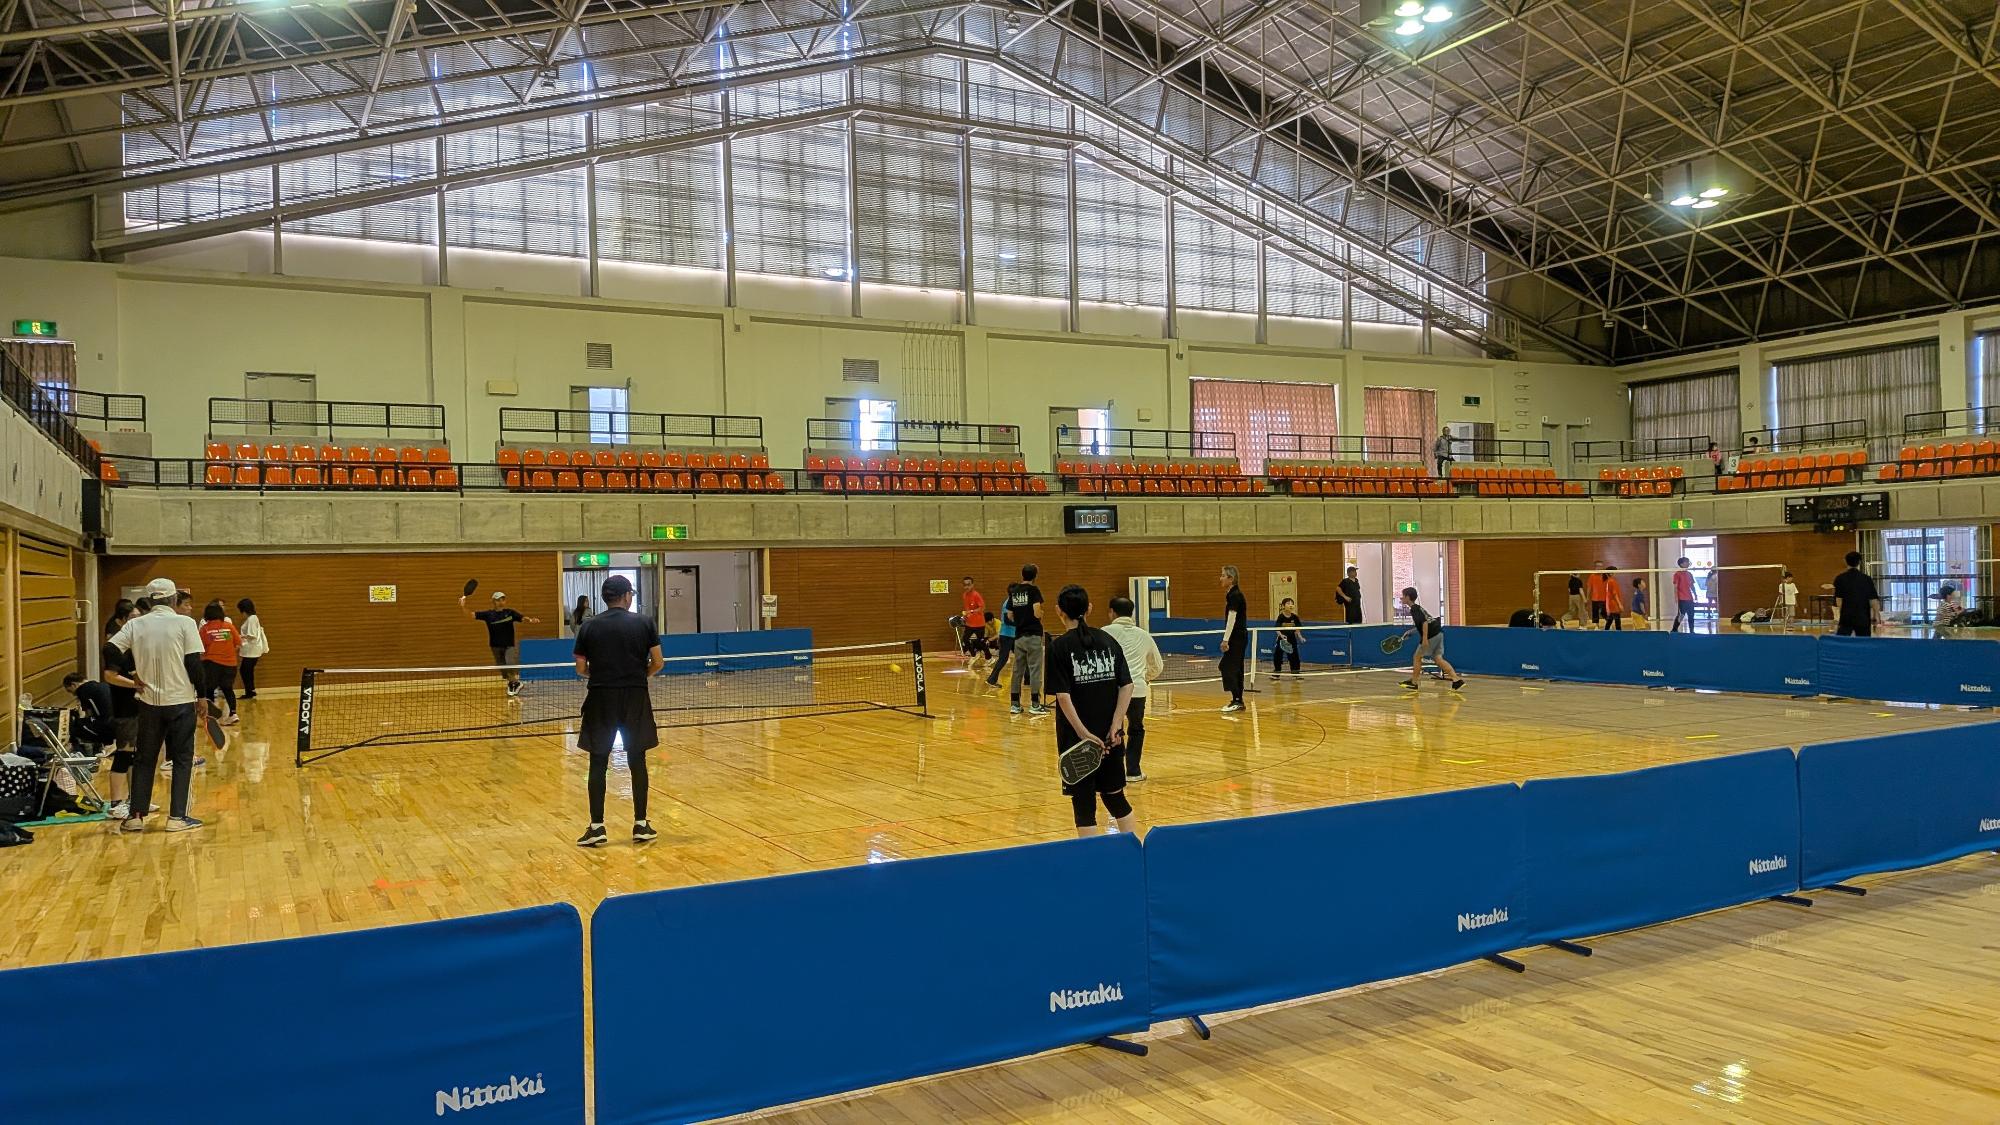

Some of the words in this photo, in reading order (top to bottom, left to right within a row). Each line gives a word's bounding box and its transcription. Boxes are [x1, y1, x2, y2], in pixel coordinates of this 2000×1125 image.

[1960, 683, 1993, 693] Nittaku
[1749, 854, 1788, 876] Nittaku
[1457, 906, 1509, 933] Nittaku
[1050, 982, 1124, 1013] Nittaku
[436, 1072, 546, 1116] Nittaku
